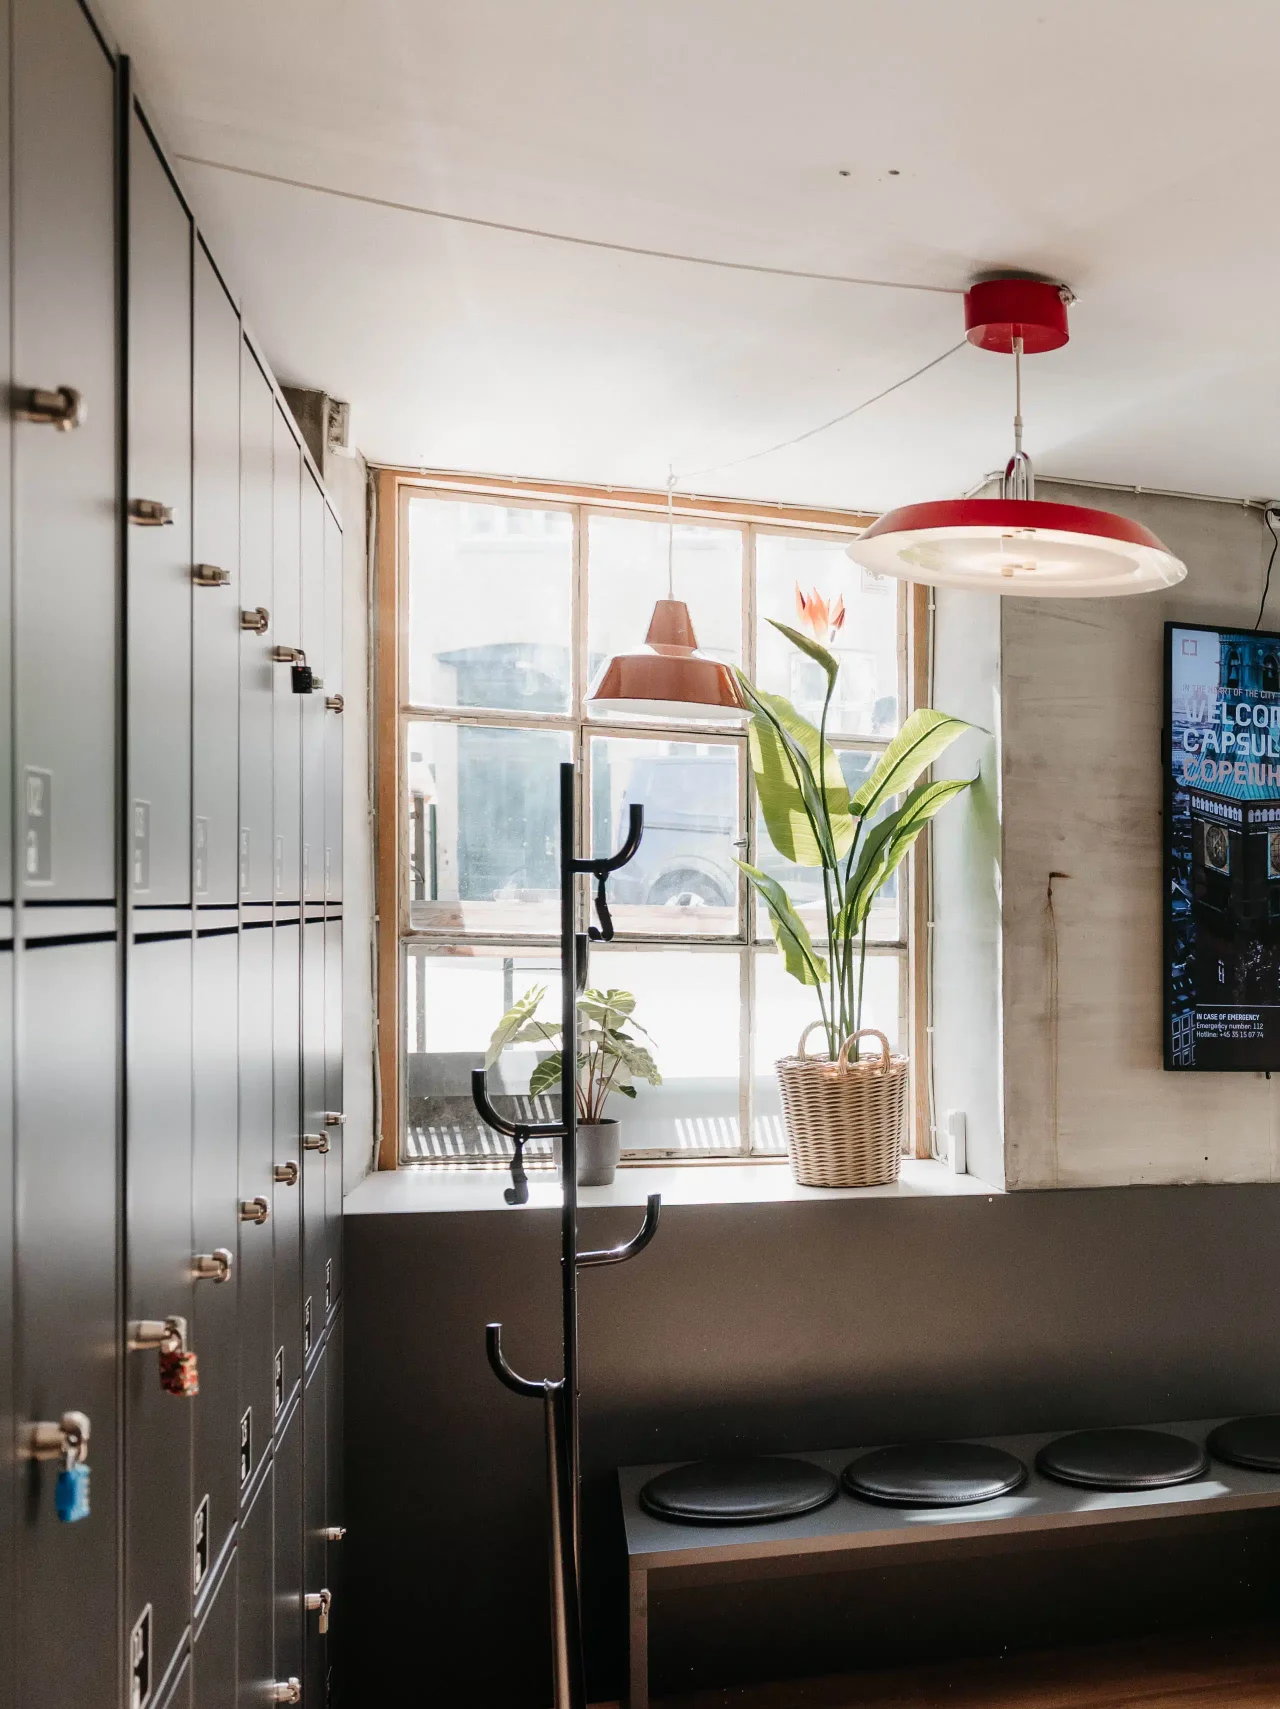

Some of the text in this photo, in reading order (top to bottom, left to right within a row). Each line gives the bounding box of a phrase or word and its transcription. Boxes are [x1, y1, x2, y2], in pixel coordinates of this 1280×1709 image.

[1193, 684, 1205, 693] THE
[1233, 688, 1243, 696] OF
[1246, 689, 1259, 698] THE
[1260, 690, 1276, 699] CITY
[1227, 1013, 1260, 1021] EMERGENCY
[1196, 1022, 1264, 1031] Emergency number: 112
